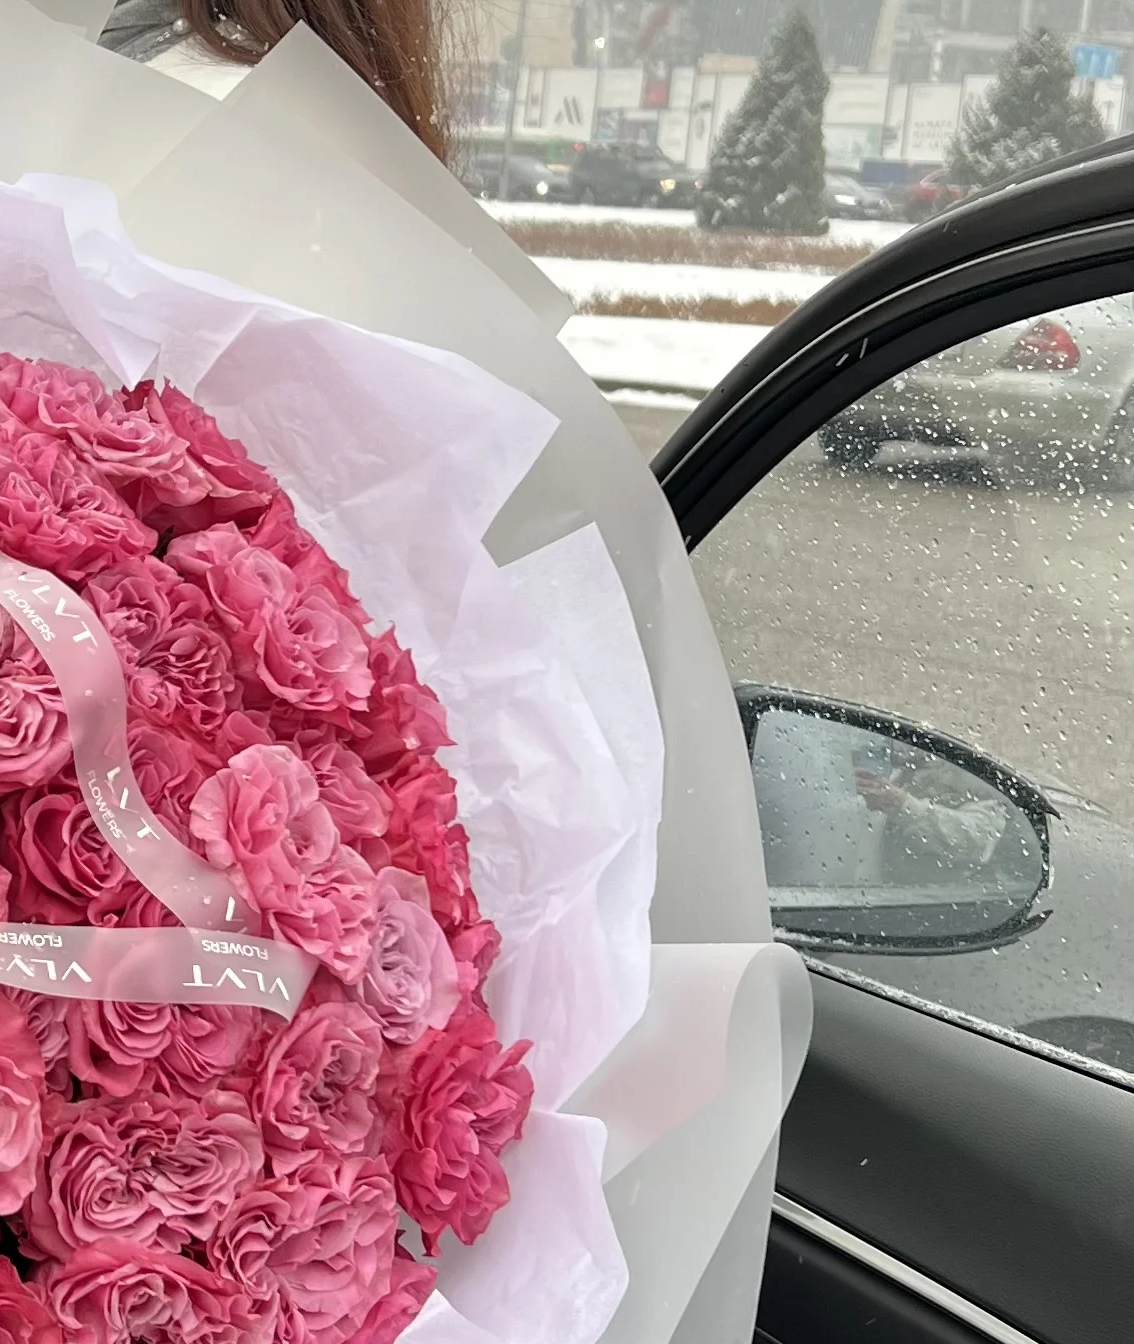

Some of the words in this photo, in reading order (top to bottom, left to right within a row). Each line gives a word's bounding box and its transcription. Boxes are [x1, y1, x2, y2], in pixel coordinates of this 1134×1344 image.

[3, 589, 56, 643] FLOWERS
[18, 572, 98, 648] VLVT
[86, 770, 125, 839] FLOWERS
[201, 939, 269, 960] FLOWERS
[182, 964, 290, 1002] VLVT
